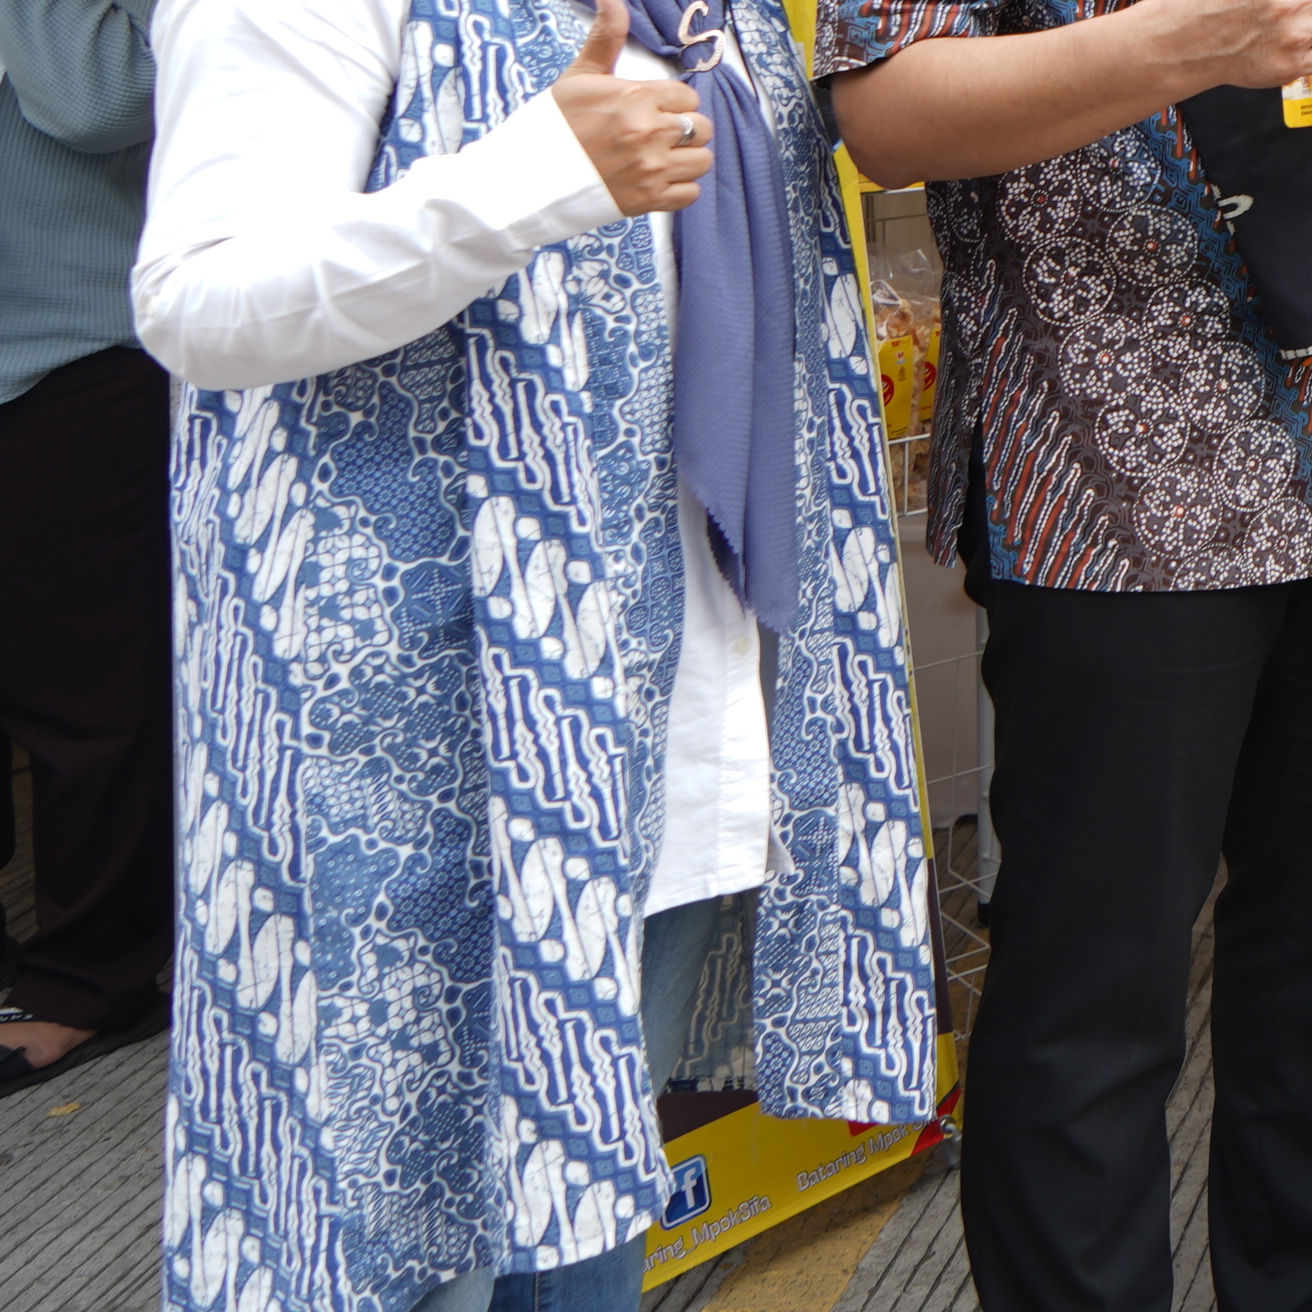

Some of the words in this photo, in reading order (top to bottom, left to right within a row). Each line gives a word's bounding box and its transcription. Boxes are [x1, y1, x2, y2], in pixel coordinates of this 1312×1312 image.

[796, 1141, 867, 1193] Bataring
[867, 1120, 912, 1155] Mpok
[643, 1193, 773, 1274] aring_MpokSifa
